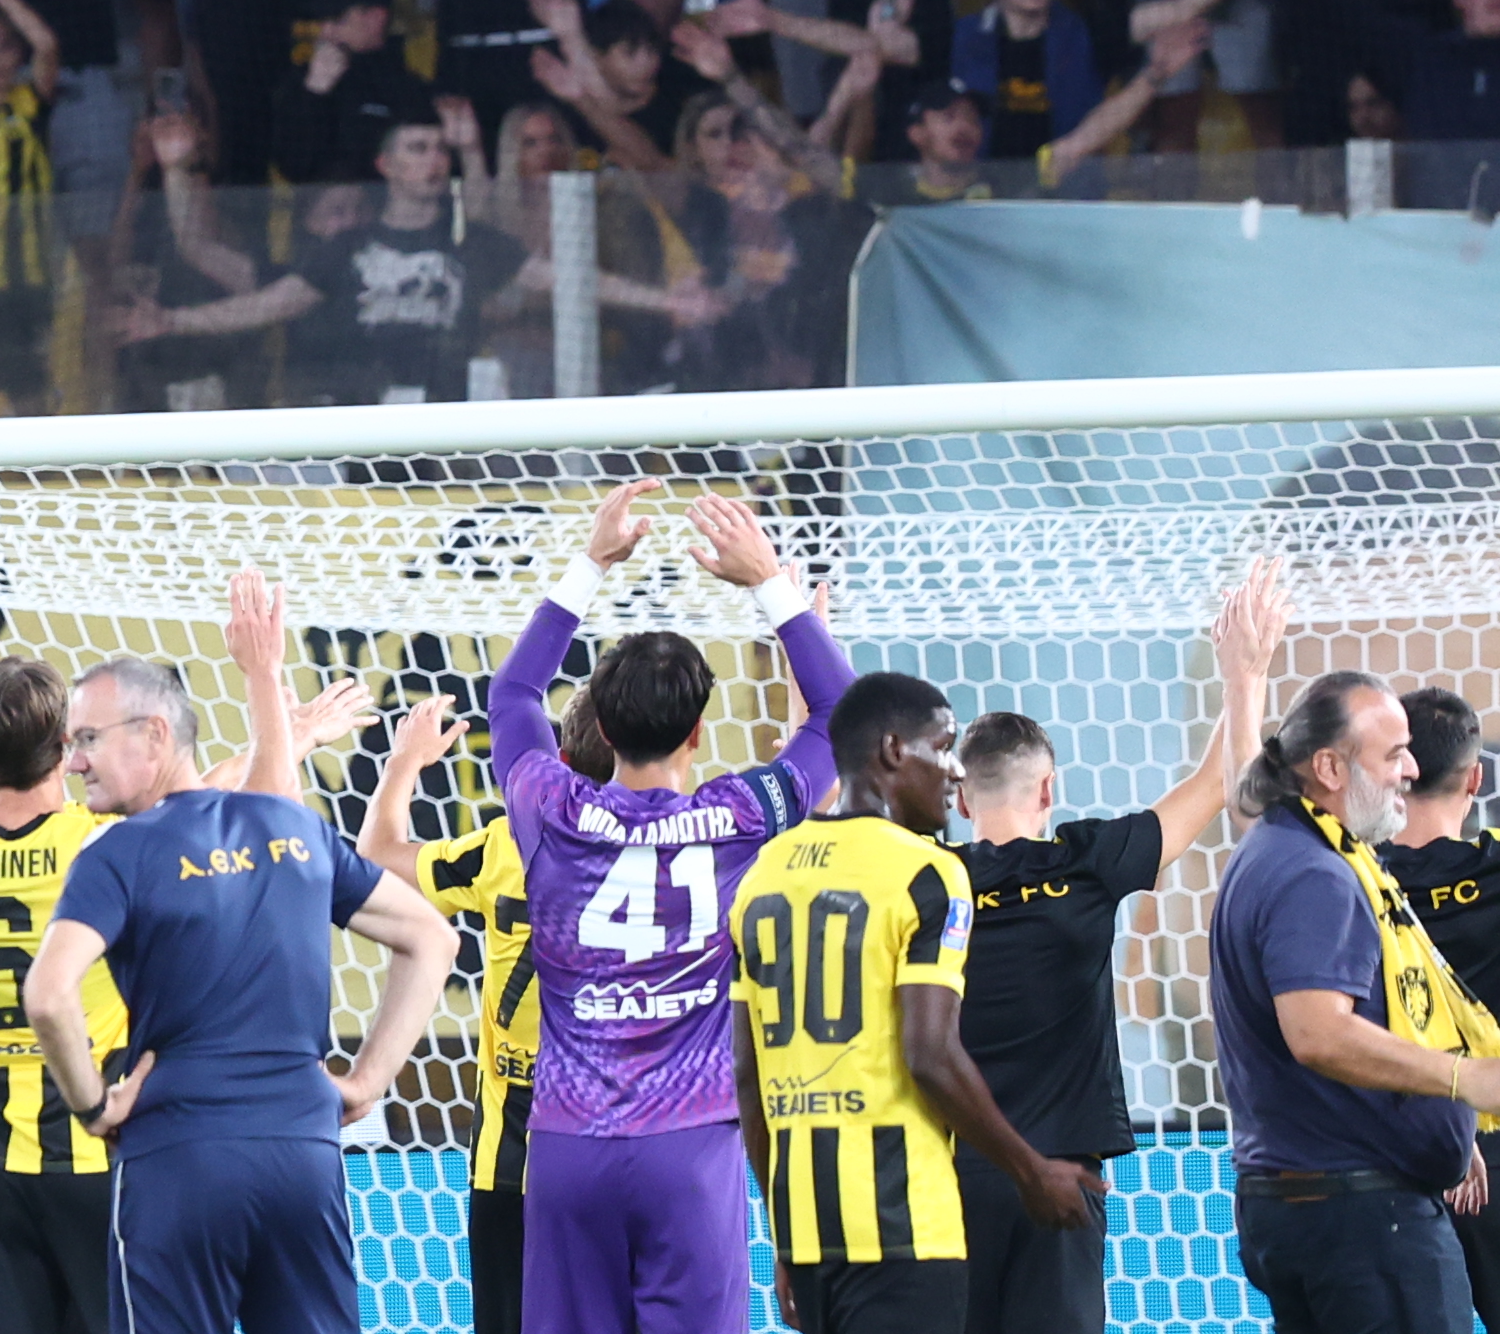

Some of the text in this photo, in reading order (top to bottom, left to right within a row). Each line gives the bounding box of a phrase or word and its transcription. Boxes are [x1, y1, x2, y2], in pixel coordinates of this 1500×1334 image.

[268, 836, 311, 864] FC
[786, 841, 838, 871] ZINE
[577, 844, 719, 964] 41
[1431, 879, 1480, 910] FC
[742, 889, 870, 1049] 90
[573, 979, 718, 1020] SEAJETS
[767, 1090, 866, 1119] SEAJETS
